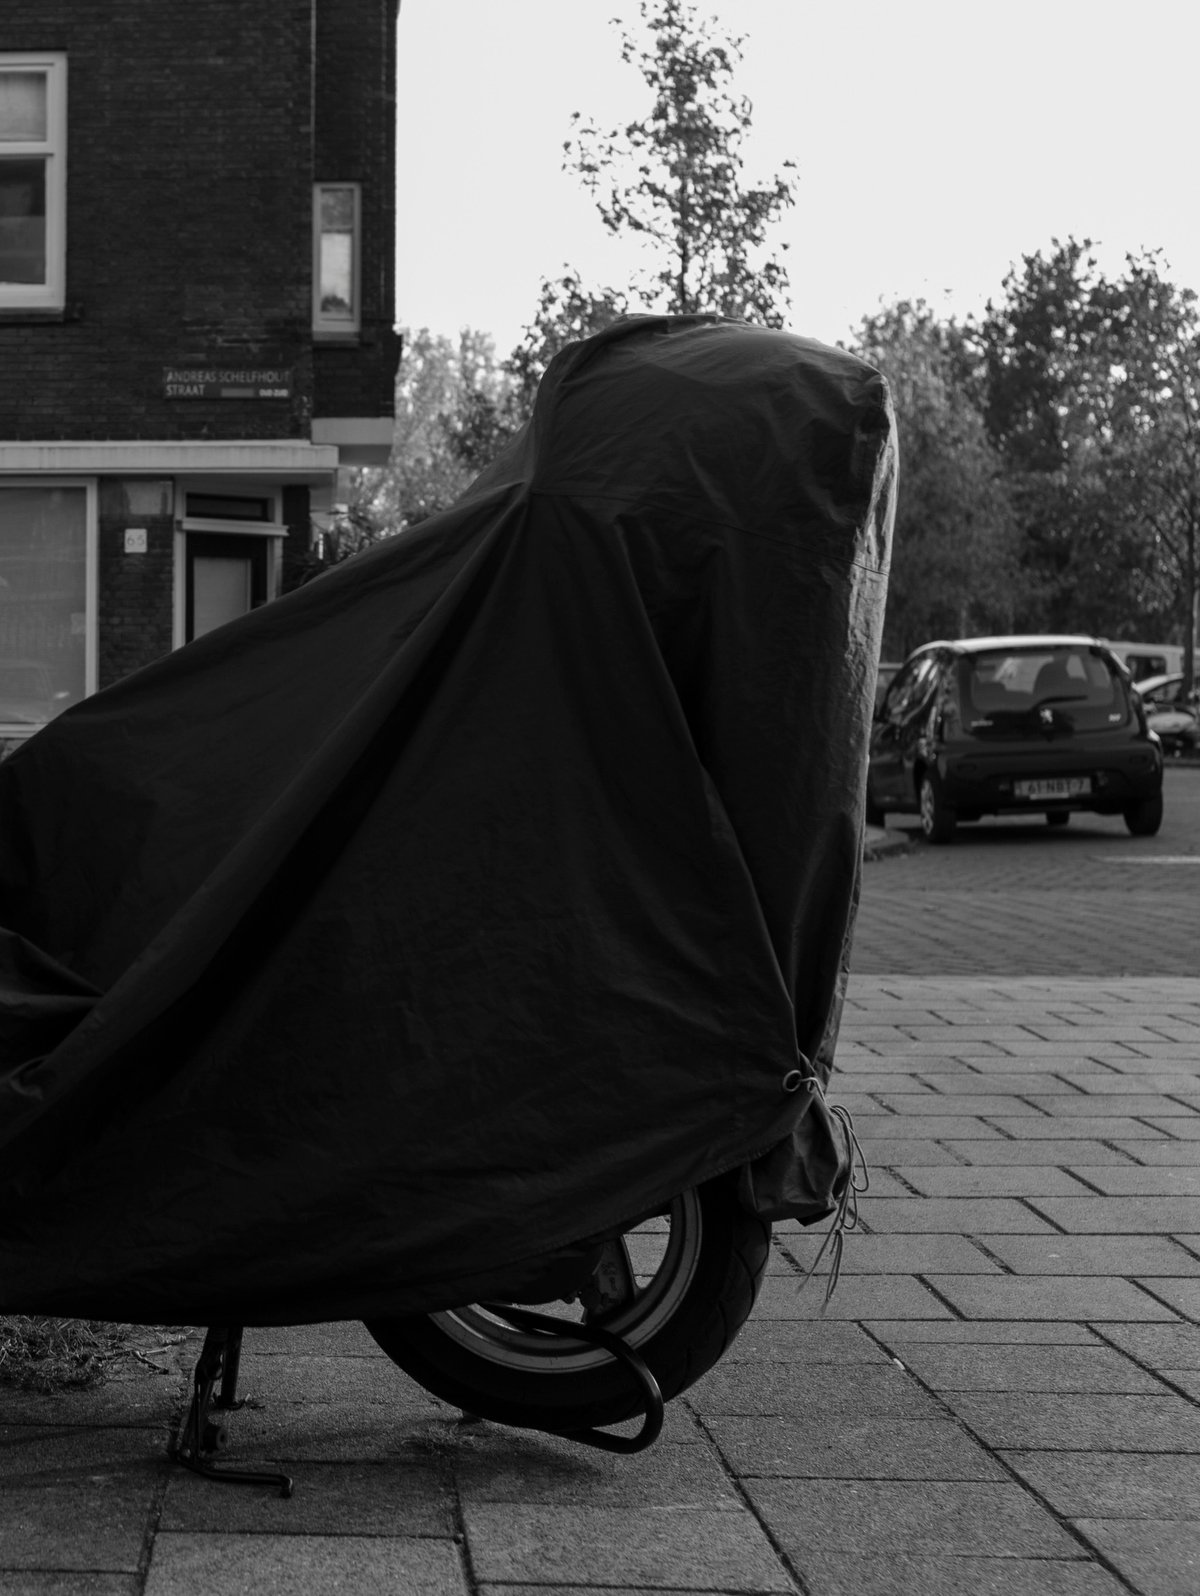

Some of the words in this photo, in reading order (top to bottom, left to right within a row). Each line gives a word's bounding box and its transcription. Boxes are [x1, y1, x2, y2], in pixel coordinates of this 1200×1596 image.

[166, 370, 217, 382] ANDREAS
[219, 370, 290, 383] SCHELFHOUT
[166, 384, 206, 396] STRAAT
[127, 534, 145, 546] 65
